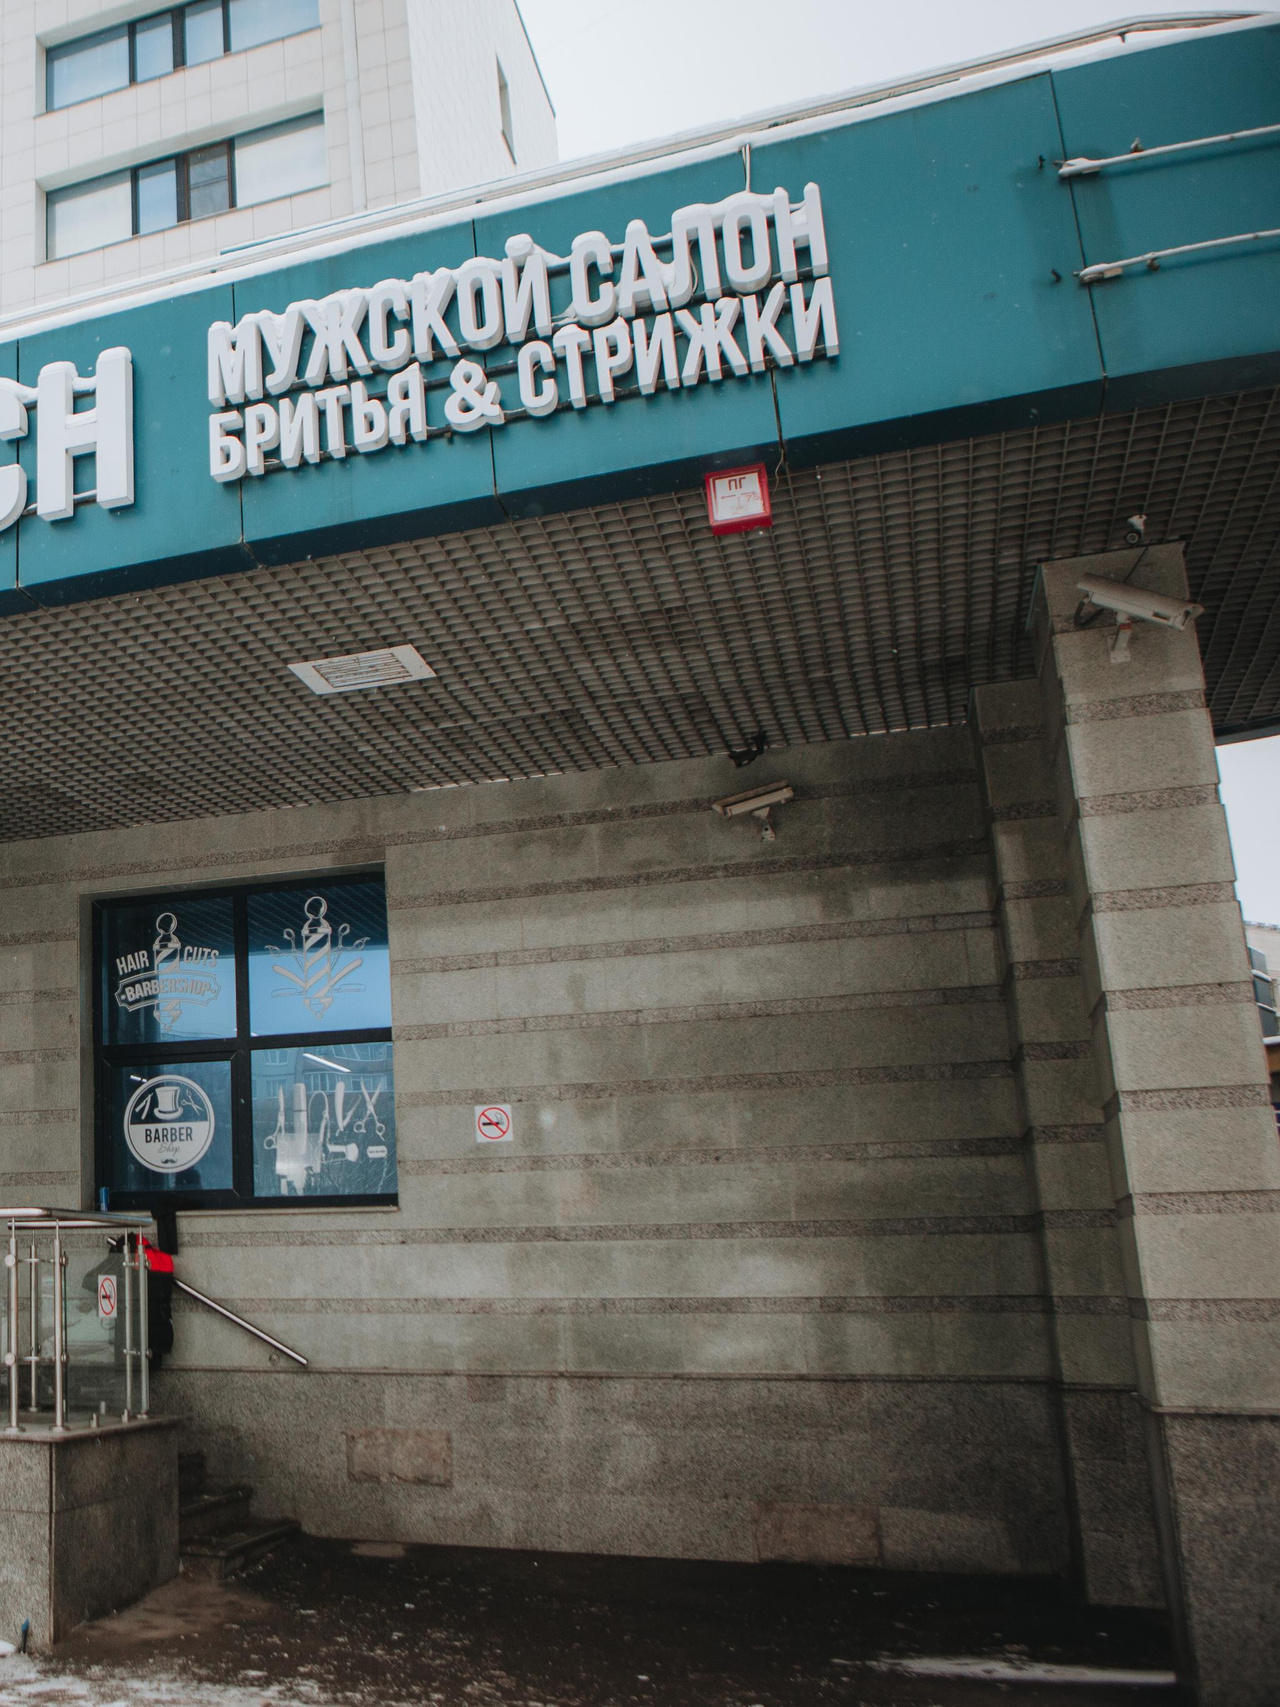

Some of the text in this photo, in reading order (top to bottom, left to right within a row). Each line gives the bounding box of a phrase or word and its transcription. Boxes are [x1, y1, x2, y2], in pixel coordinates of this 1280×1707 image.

[207, 182, 830, 407] МУЖСКОЙ САЛОН
[208, 277, 840, 483] БРИТЬЯ & СТРИЖКИ
[728, 476, 747, 491] ПГ
[116, 945, 220, 975] HAIR CUTS
[145, 1126, 194, 1143] BARBER
